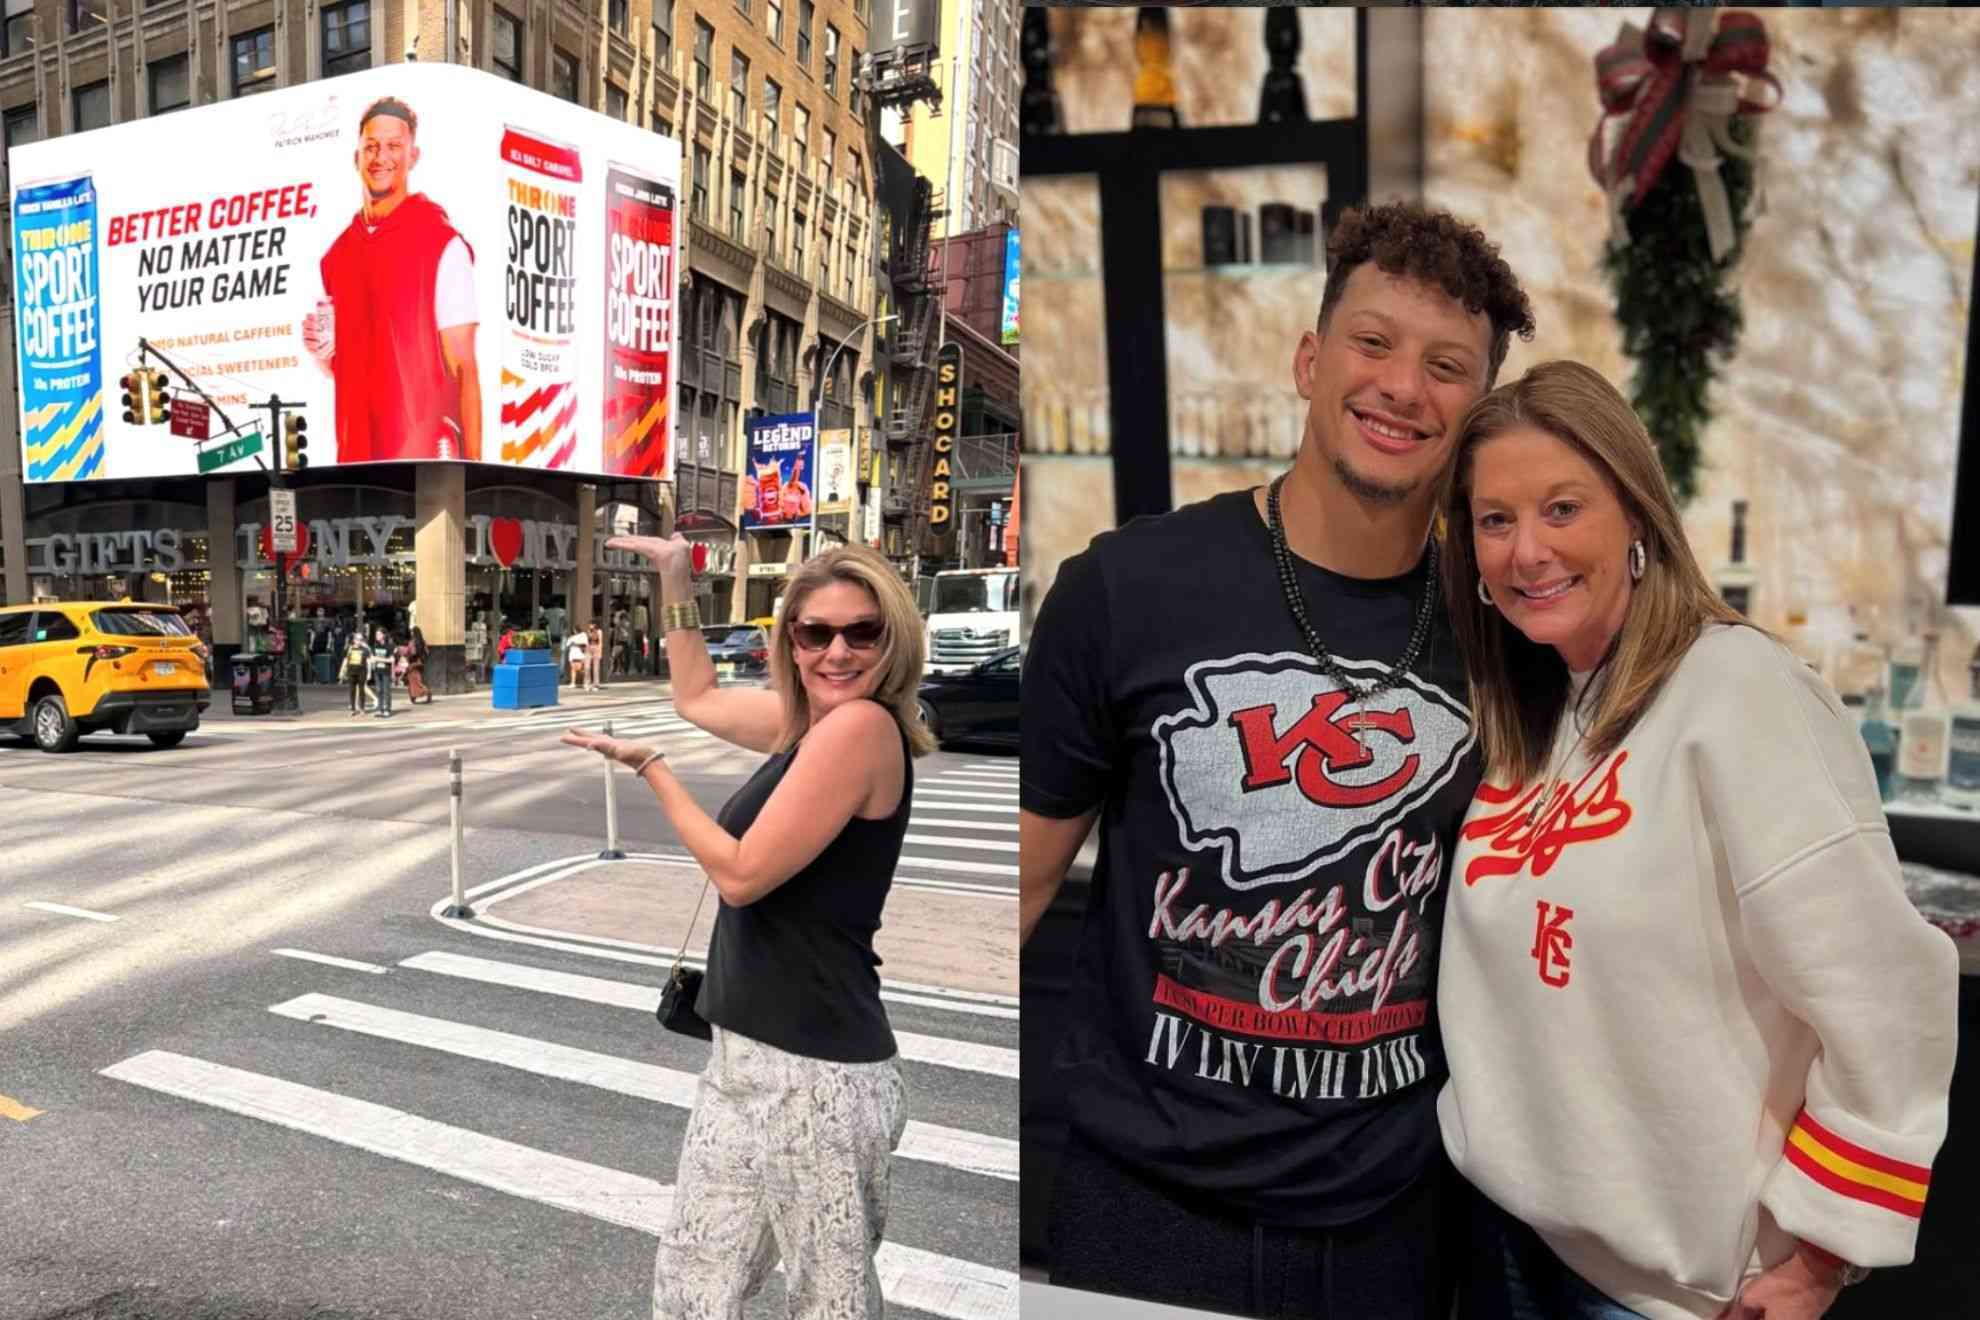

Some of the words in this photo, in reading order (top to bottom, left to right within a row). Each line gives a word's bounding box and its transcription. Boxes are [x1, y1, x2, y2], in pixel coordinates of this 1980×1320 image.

[108, 202, 202, 246] BETTER
[208, 182, 317, 229] COFFEE,
[508, 177, 577, 218] THRONE
[138, 244, 173, 277] NO
[180, 226, 286, 271] MATTER
[508, 204, 577, 277] SPORT
[611, 232, 671, 299] SPORT
[22, 242, 93, 306] SPORT
[138, 276, 204, 312] YOUR
[212, 264, 290, 303] GAME
[505, 263, 576, 334] COFFEE
[24, 295, 96, 359] COFFEE
[176, 331, 230, 347] NATURAL
[233, 323, 293, 340] CAFFEINE
[607, 287, 672, 352] COFFEE
[217, 355, 299, 375] SWEETENERS
[216, 451, 225, 463] 7
[229, 444, 245, 459] AV
[754, 426, 812, 445] LEGEND
[762, 440, 801, 452] RETURNS
[929, 363, 955, 524] SHOCARD
[44, 527, 184, 575] GIFTS
[275, 515, 293, 532] 25
[309, 515, 406, 566] NY
[522, 519, 577, 568] NY
[1228, 689, 1420, 809] KC
[1363, 829, 1443, 915] City
[1149, 867, 1348, 947] Kansas
[1259, 909, 1420, 1016] Chiefs
[1531, 900, 1574, 989] KC
[1252, 1011, 1318, 1040] BOWL
[1324, 1006, 1424, 1041] CHAMPIONS
[1145, 1013, 1193, 1070] IV
[1195, 1029, 1264, 1087] LIV
[1272, 1046, 1351, 1099] LVII
[1357, 1034, 1425, 1099] LVIII
